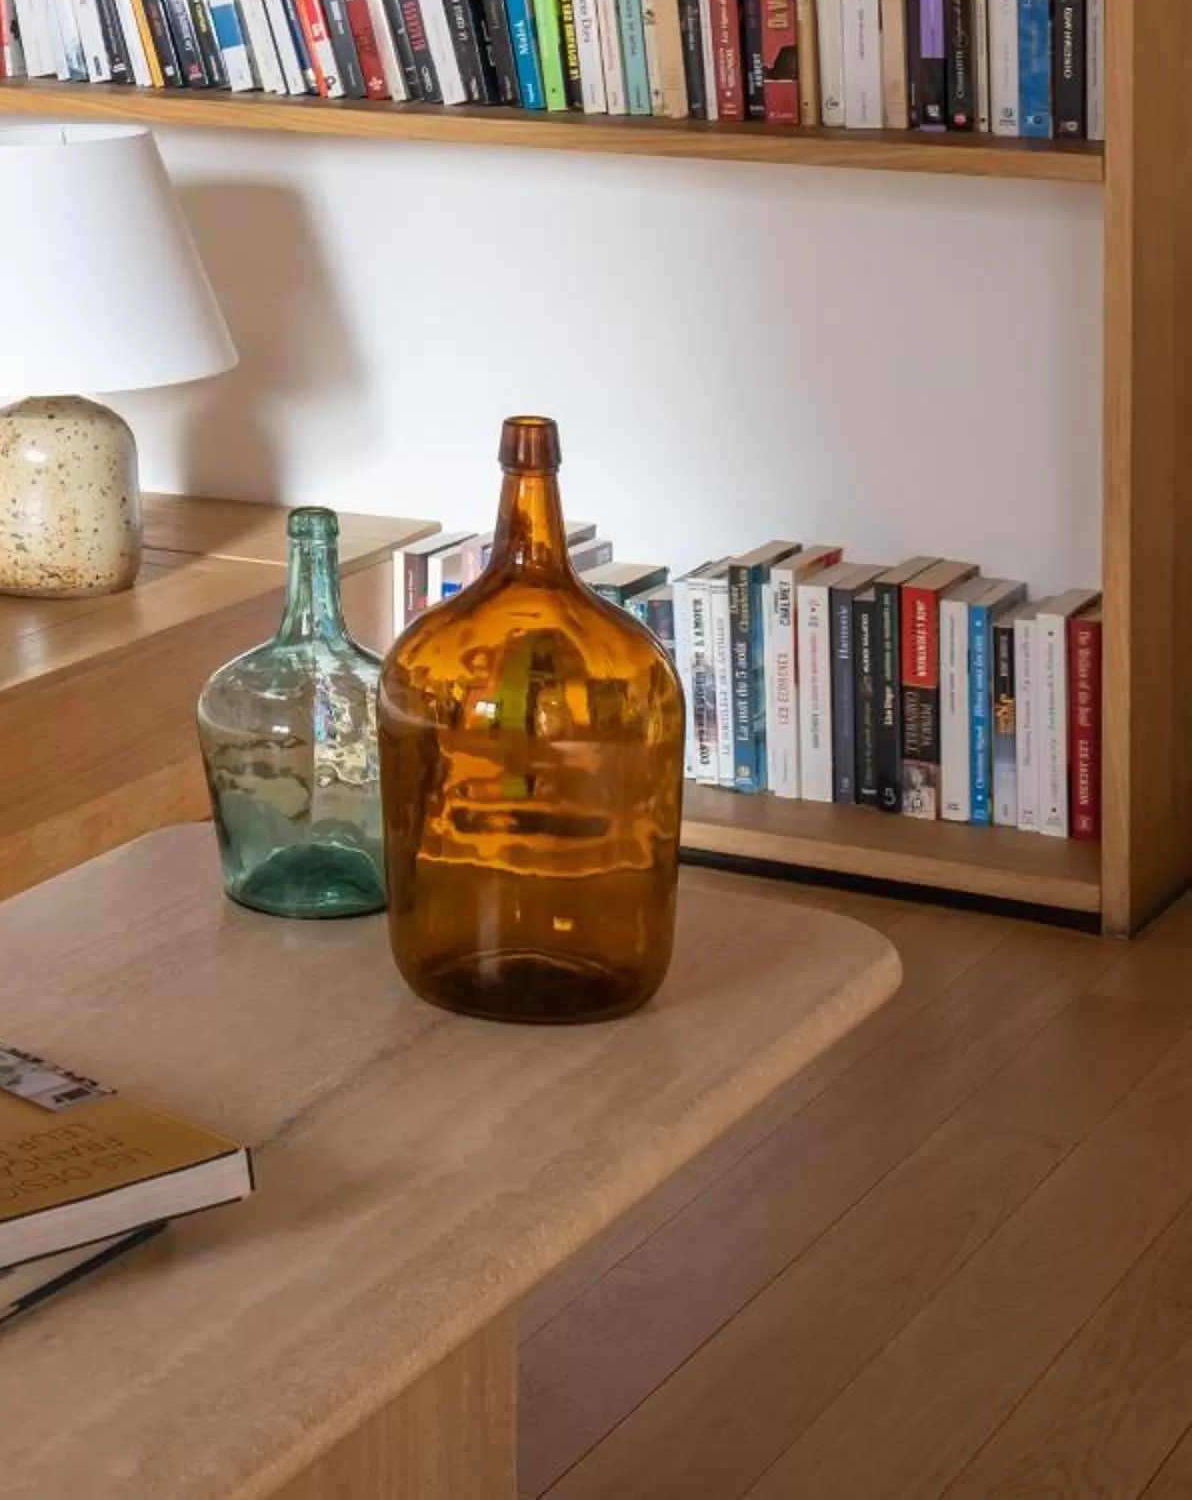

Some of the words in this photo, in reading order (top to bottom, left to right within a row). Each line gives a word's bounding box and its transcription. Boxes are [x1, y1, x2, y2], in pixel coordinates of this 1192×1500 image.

[568, 67, 580, 81] LE
[735, 682, 748, 697] du
[735, 701, 749, 723] nuit
[736, 726, 750, 741] La
